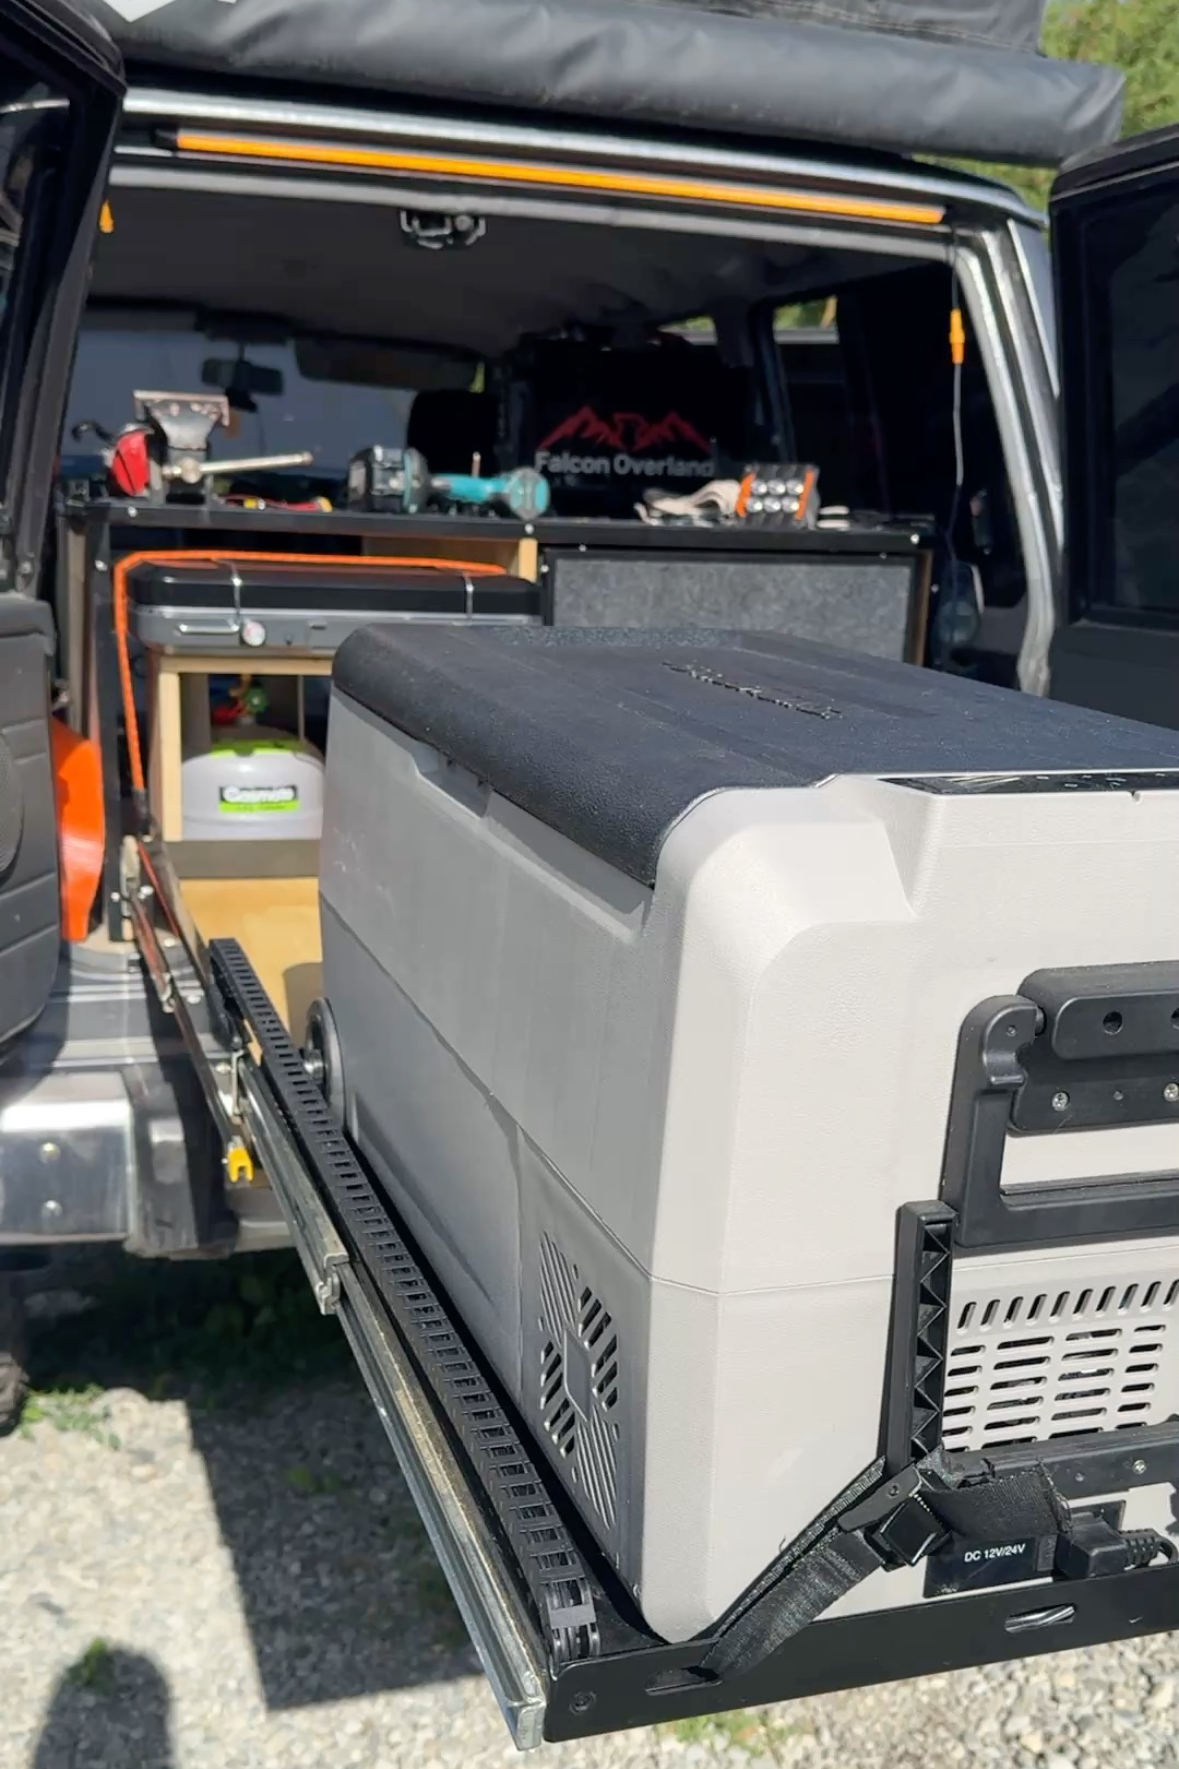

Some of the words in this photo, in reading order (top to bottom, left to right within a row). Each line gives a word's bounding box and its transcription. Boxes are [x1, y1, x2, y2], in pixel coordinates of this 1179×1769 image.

[534, 451, 611, 475] Falcon
[613, 453, 715, 477] Overland
[964, 1550, 982, 1563] DC
[984, 1543, 1026, 1559] 12V/24V
